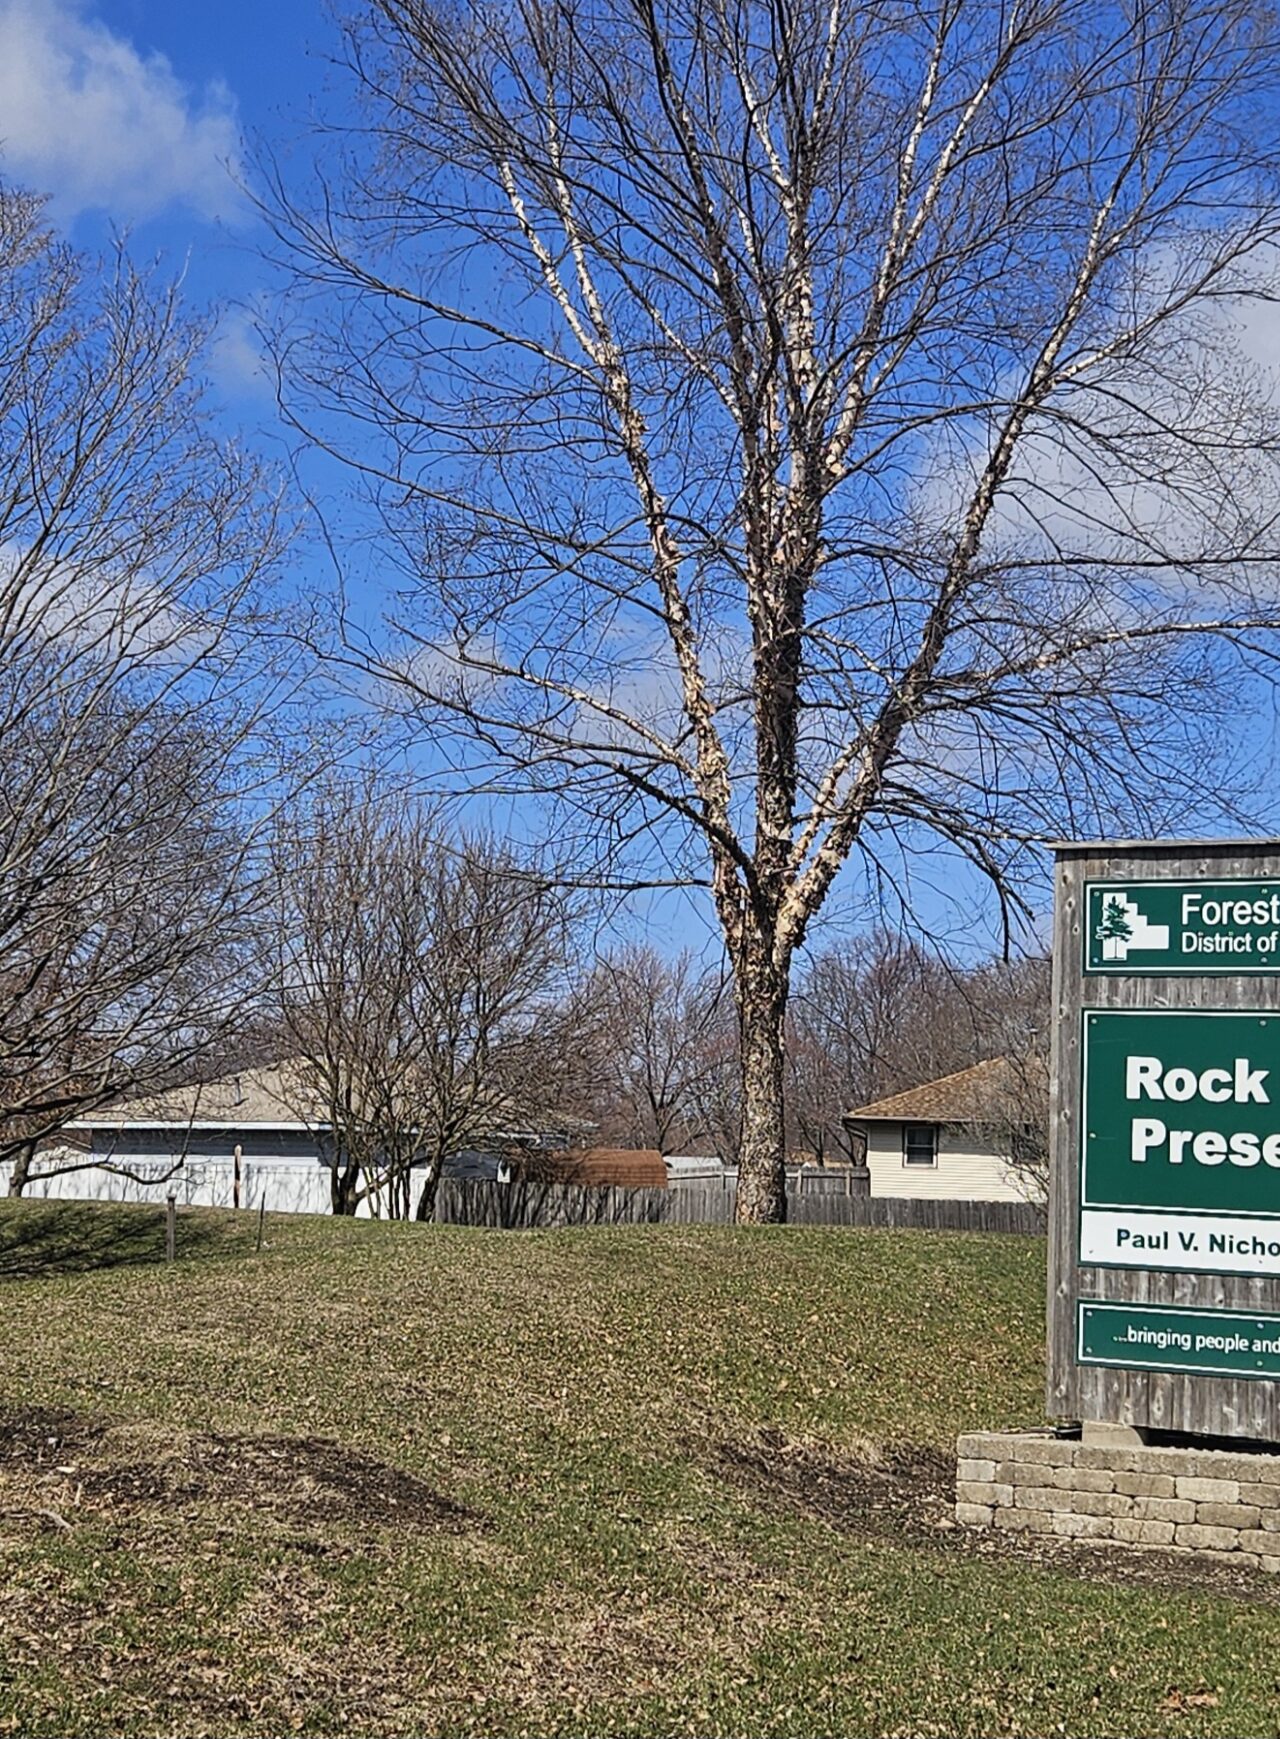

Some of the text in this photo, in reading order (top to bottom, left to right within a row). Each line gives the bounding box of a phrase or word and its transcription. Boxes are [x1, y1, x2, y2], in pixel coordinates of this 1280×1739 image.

[1181, 892, 1280, 925] Forest
[1181, 931, 1252, 953] District
[1256, 932, 1276, 953] of
[1126, 1055, 1270, 1103] Rock
[1116, 1228, 1169, 1250] Paul
[1178, 1231, 1199, 1252] V.
[1195, 1332, 1249, 1354] people
